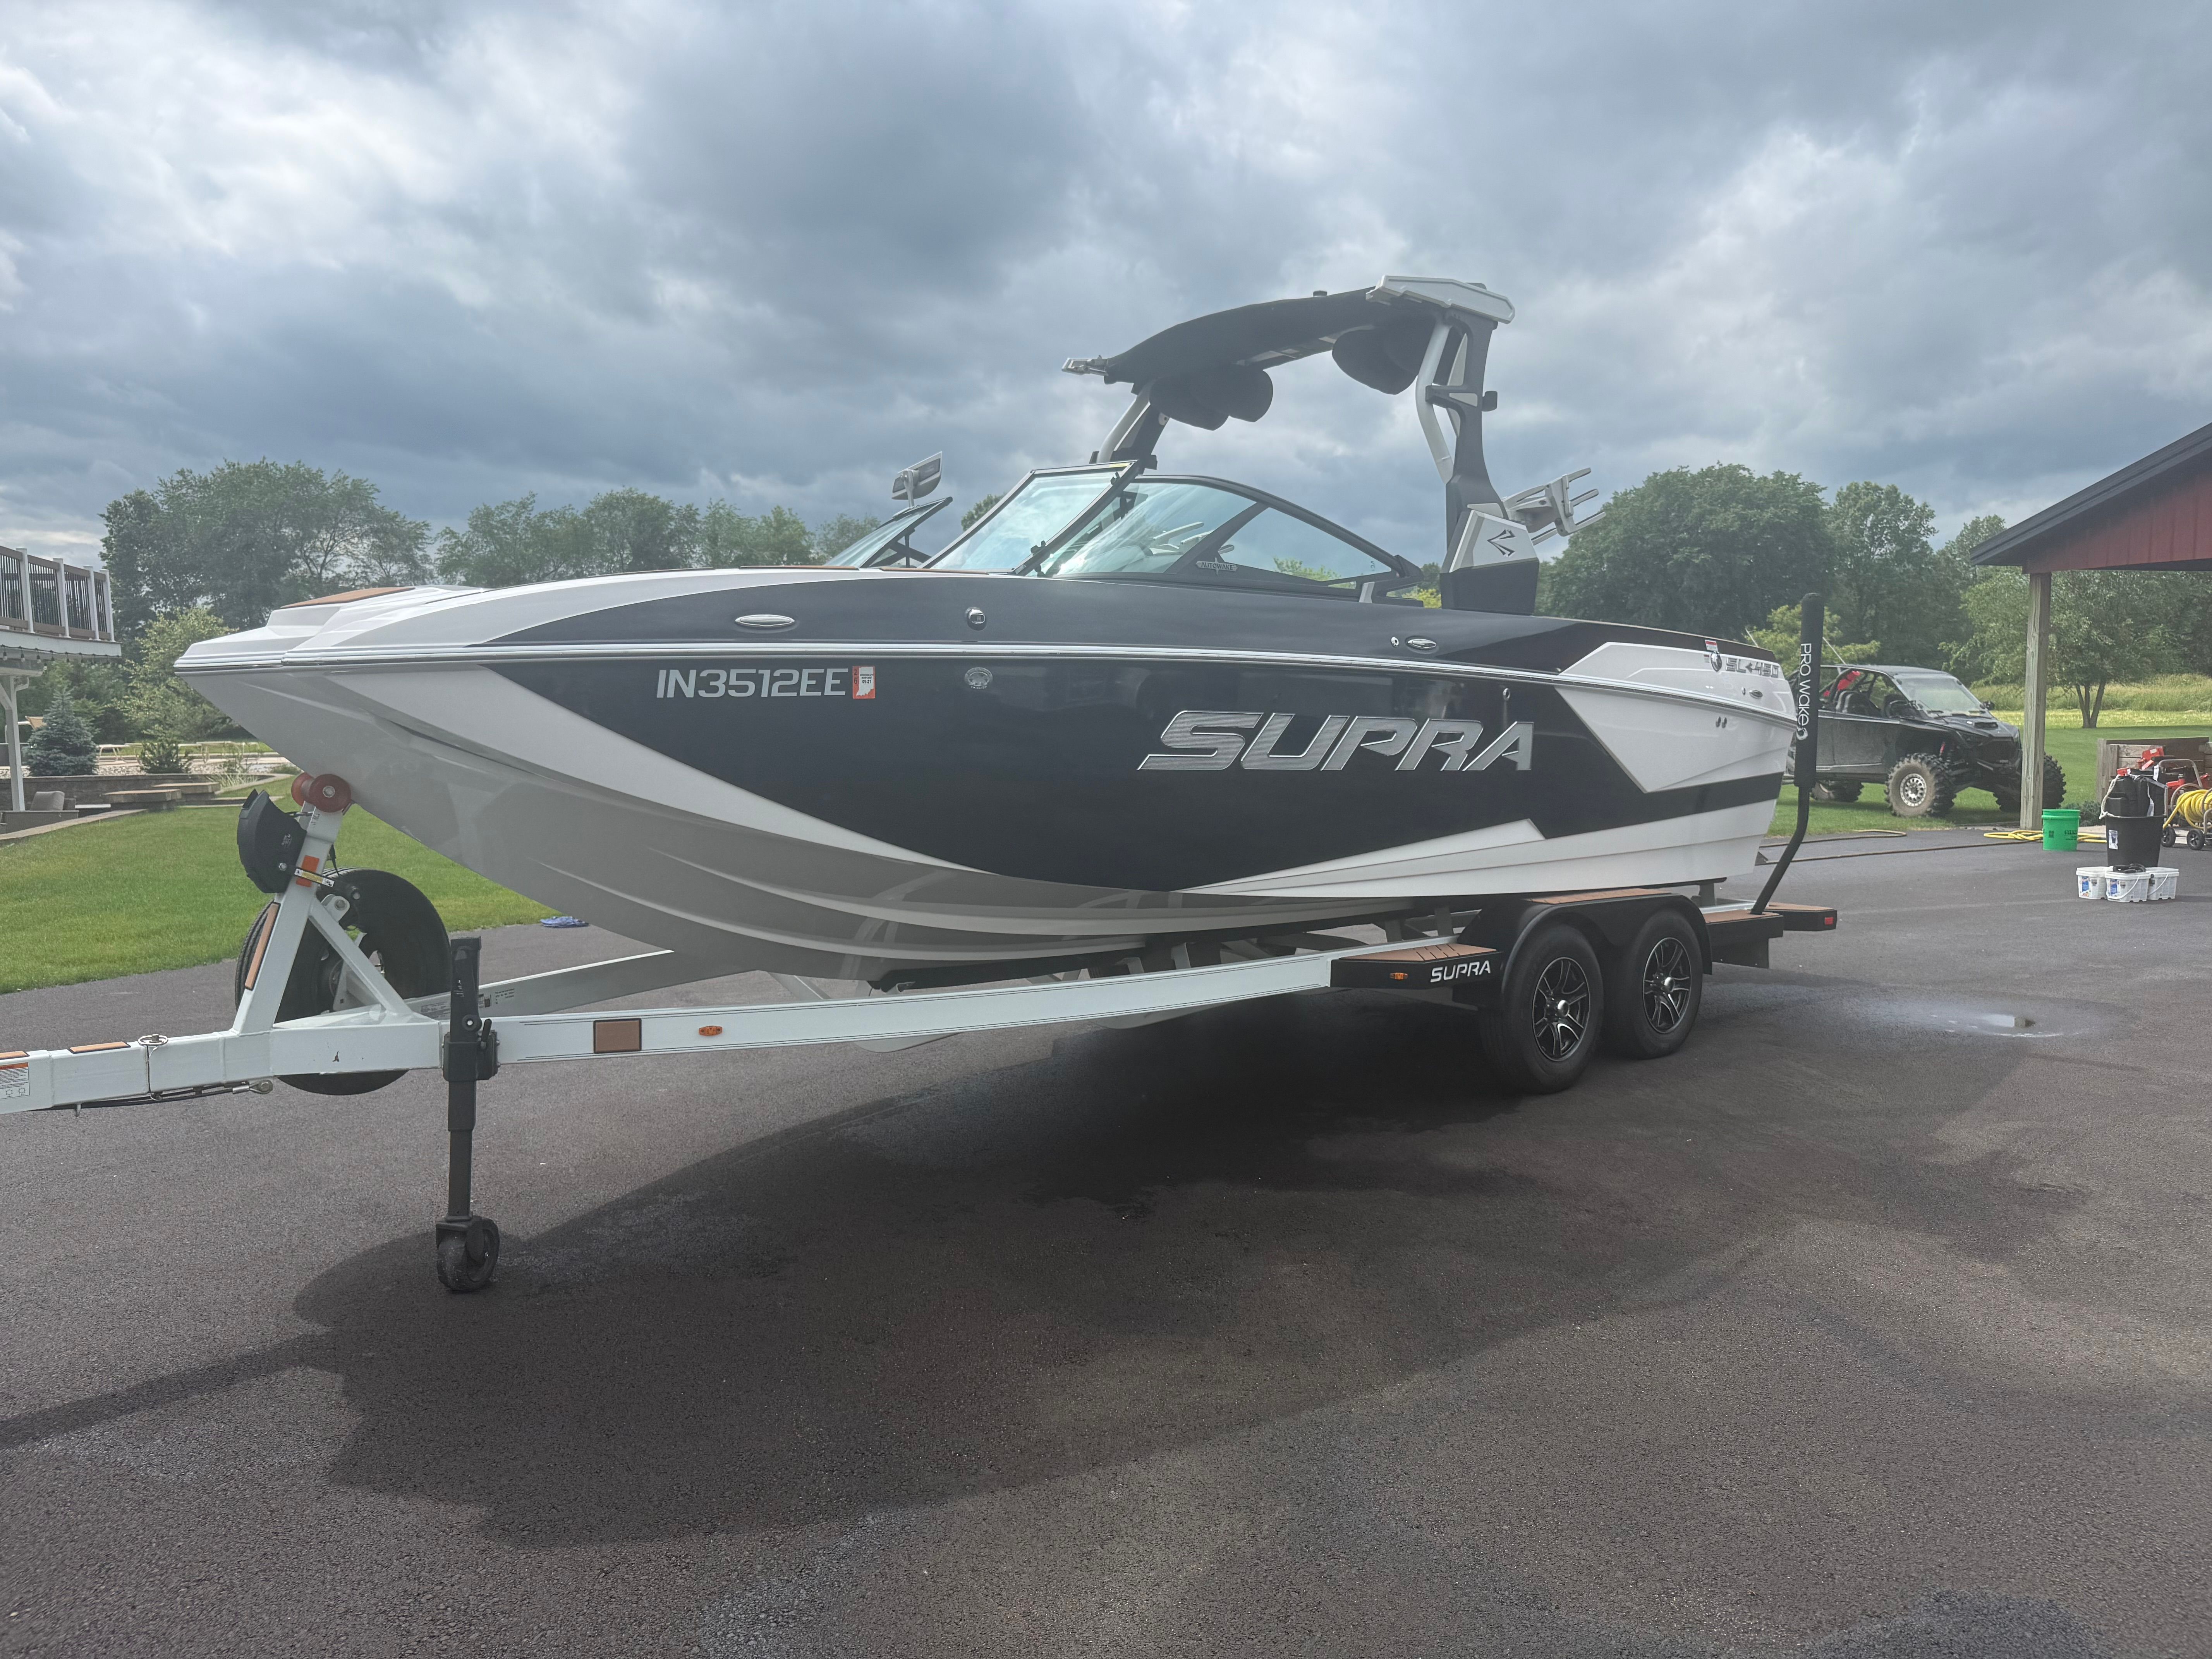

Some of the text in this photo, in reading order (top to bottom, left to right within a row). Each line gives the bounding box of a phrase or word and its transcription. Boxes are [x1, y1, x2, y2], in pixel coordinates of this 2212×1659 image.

[1201, 562, 1233, 570] AUTOWAKE
[1726, 658, 1746, 673] SL
[1800, 643, 1812, 676] PRO
[657, 668, 848, 698] IN3512EE
[1137, 710, 1534, 771] SUPRA
[1431, 960, 1490, 982] SUPRA
